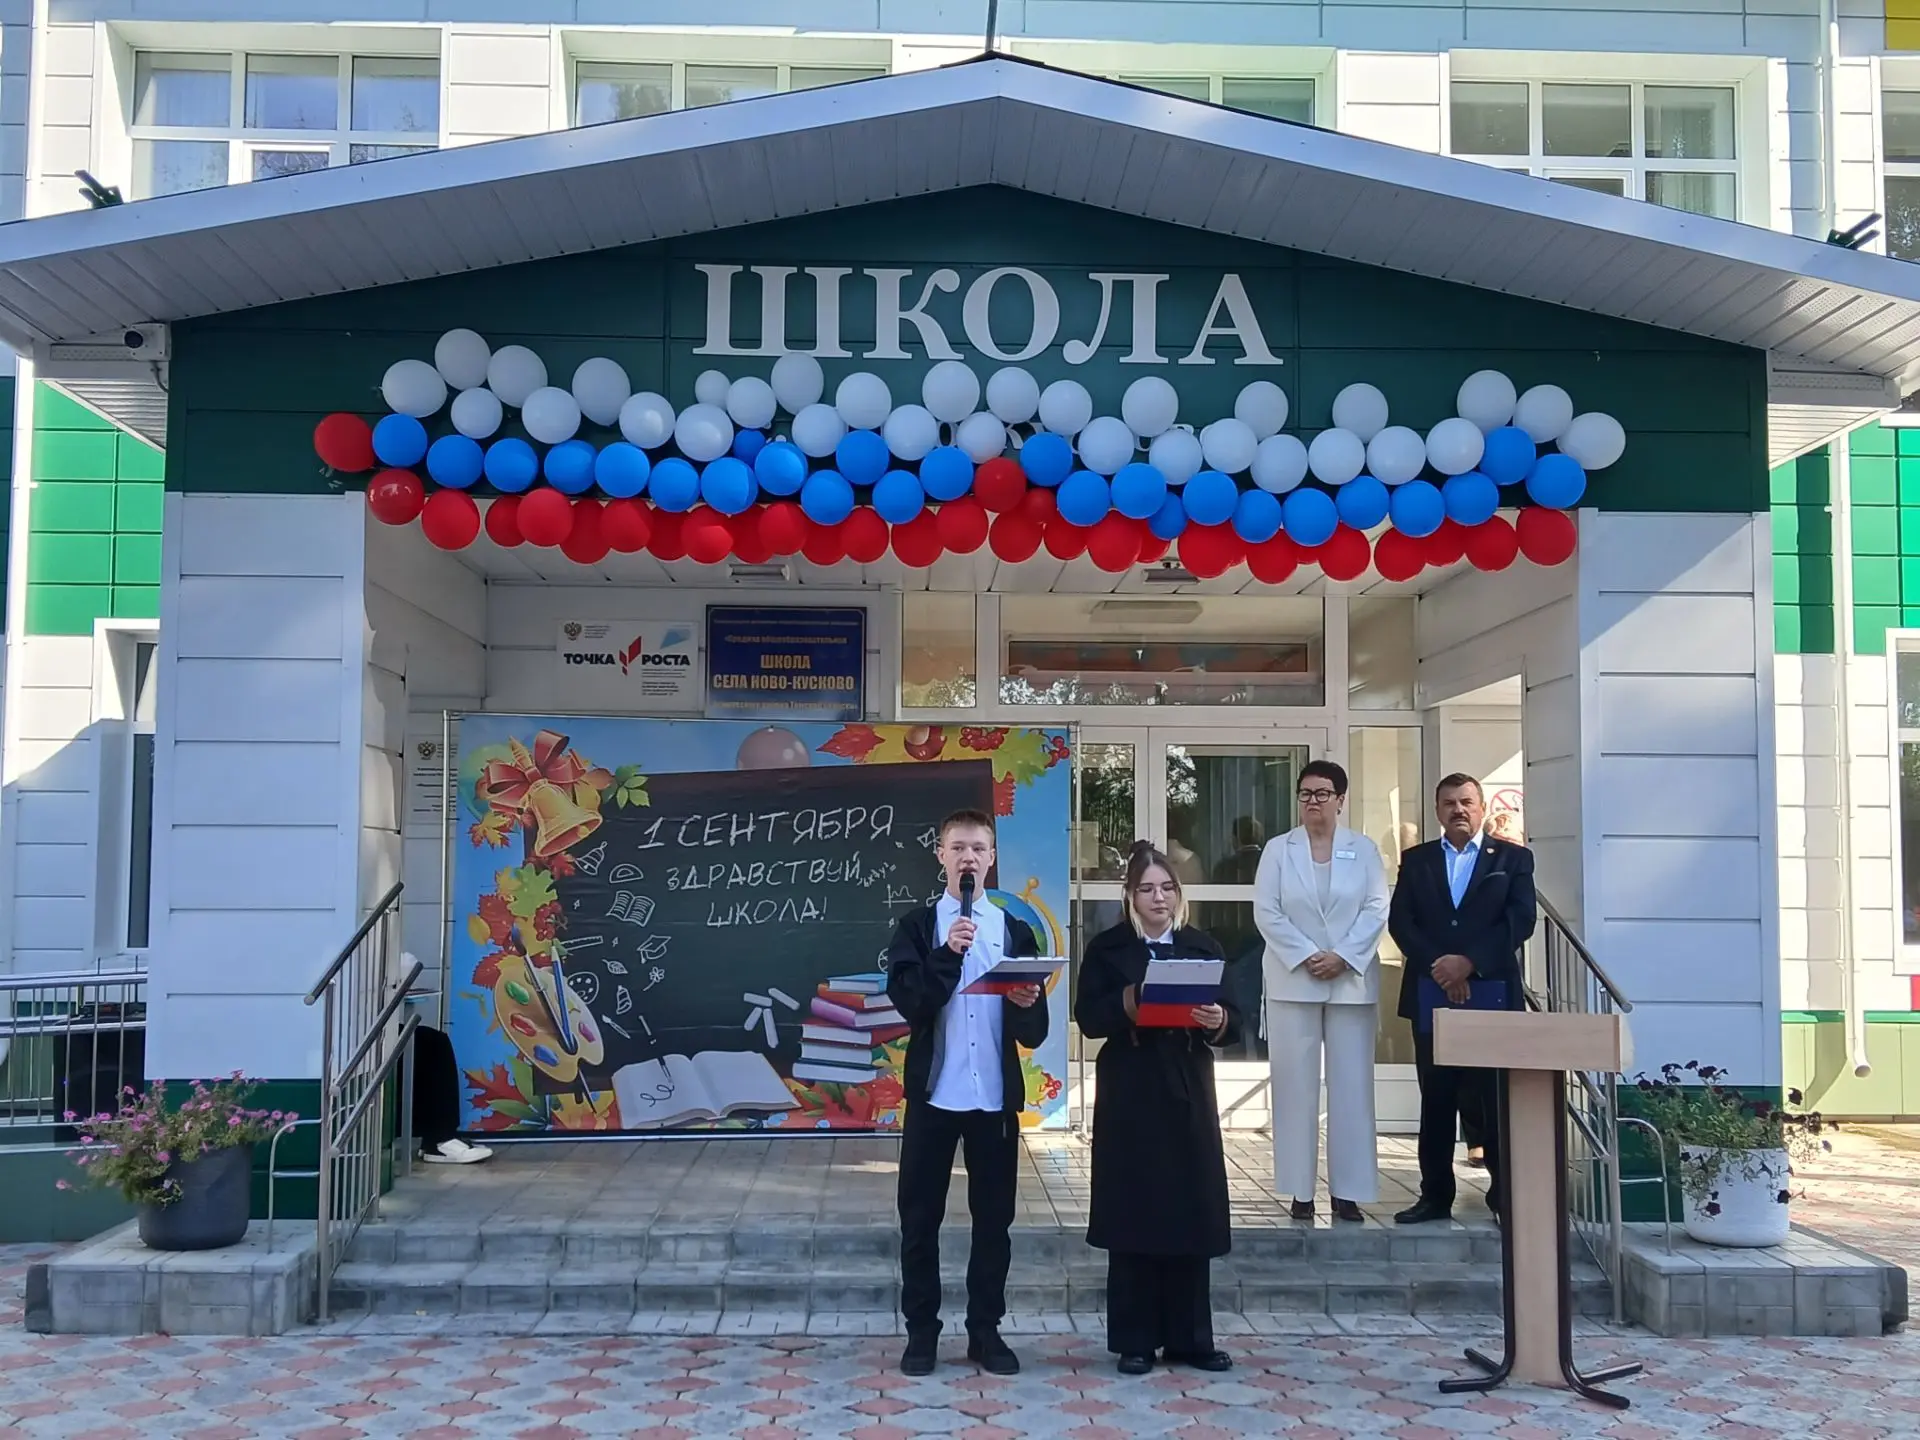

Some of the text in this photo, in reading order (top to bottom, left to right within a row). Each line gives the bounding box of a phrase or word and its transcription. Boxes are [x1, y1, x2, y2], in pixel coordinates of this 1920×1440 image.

[692, 263, 1284, 365] ШКОЛА
[563, 653, 691, 666] ТОЧКА РОСТА
[760, 654, 811, 669] ШКОЛА
[713, 674, 855, 690] СЕЛА НОВО-КУСКОВО
[638, 805, 894, 848] 1 СЕНТЯБРЯ
[706, 897, 827, 927] ШКОЛА!
